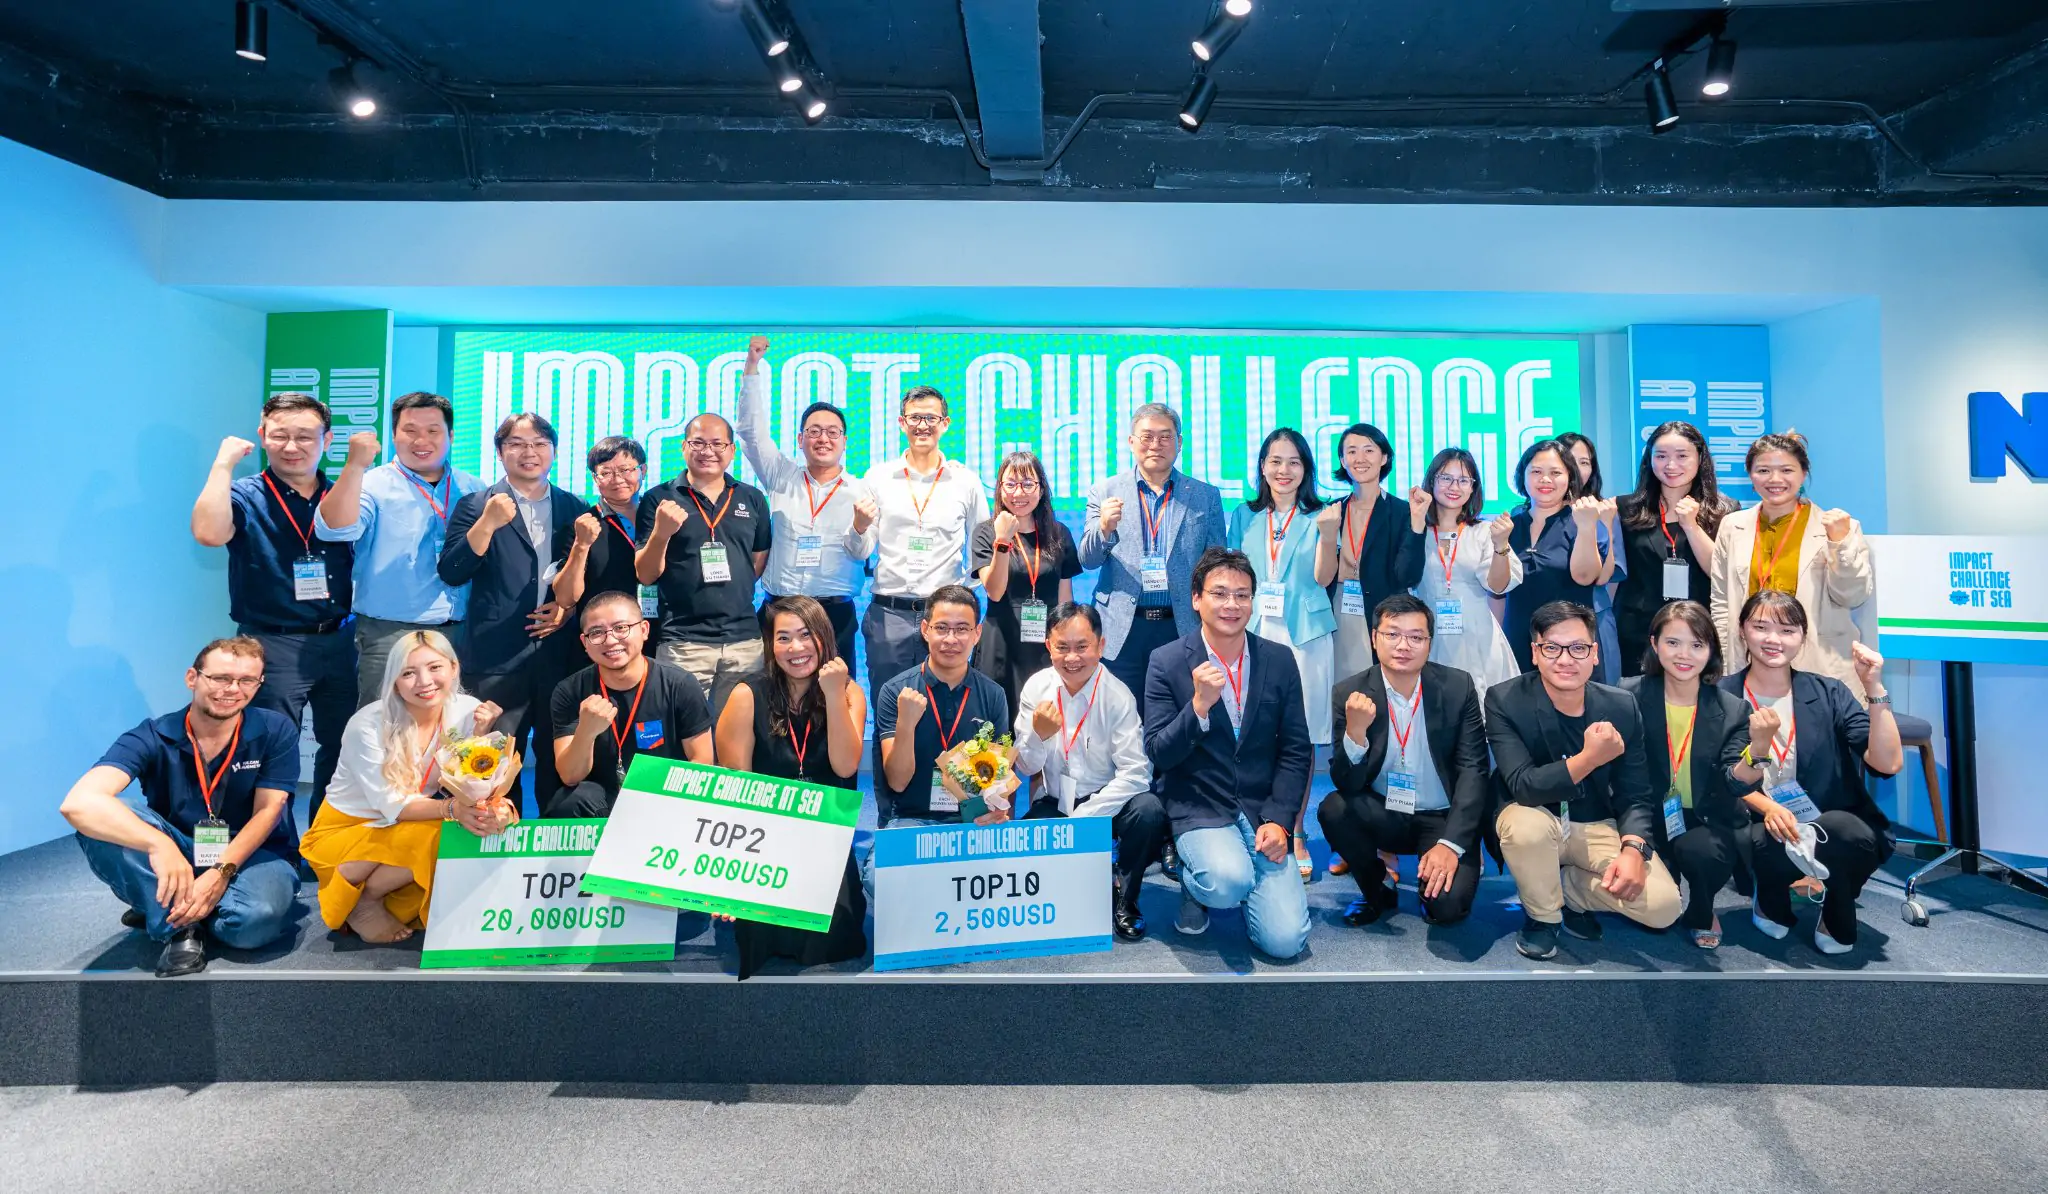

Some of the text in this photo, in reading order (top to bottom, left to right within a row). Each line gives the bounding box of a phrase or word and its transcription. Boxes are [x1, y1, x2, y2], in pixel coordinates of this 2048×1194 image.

[1639, 380, 1696, 415] AT
[965, 353, 1552, 500] CHALLENGE
[1949, 552, 1992, 570] IMPACT
[1950, 571, 2011, 589] CHALLENGE
[1971, 590, 2012, 608] AT SEA
[662, 766, 824, 817] IMPACT CHALLENGE AT SEA
[532, 825, 599, 853] CHALLENGE
[694, 818, 766, 854] TOP2
[916, 824, 1074, 860] IMPACT CHALLENGE AT SEA
[645, 845, 789, 889] 20,000USD
[951, 871, 1040, 902] TOP10
[480, 905, 625, 935] 20,000USD
[935, 902, 1056, 936] 2,500USD
